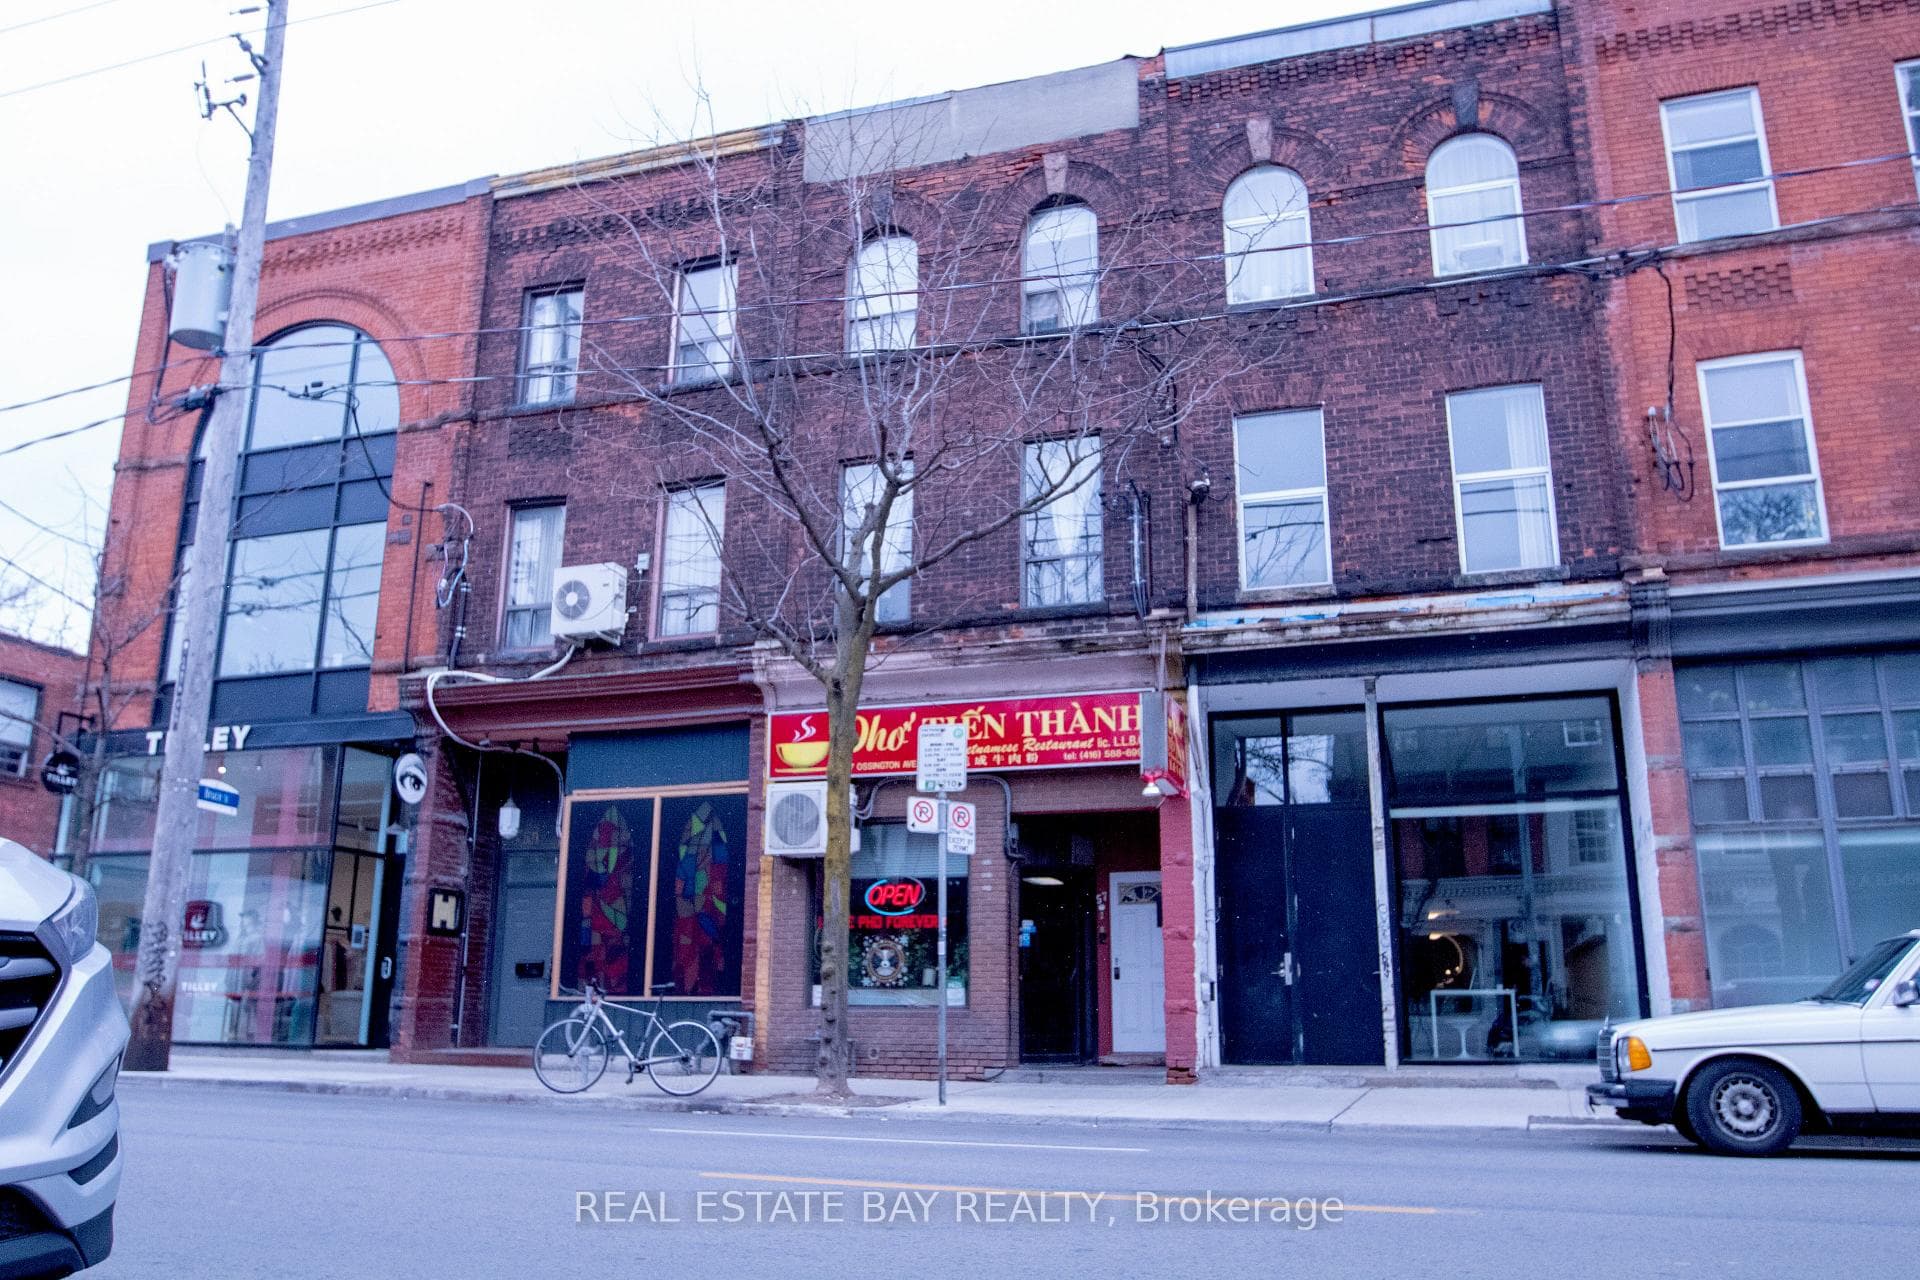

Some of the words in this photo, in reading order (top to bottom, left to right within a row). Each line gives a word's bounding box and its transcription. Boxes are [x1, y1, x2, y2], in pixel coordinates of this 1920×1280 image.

[145, 724, 251, 755] TEY
[1022, 736, 1094, 753] Restaurant
[856, 761, 900, 771] OSSINGTON
[868, 884, 921, 906] OPEN
[857, 915, 883, 929] PHO
